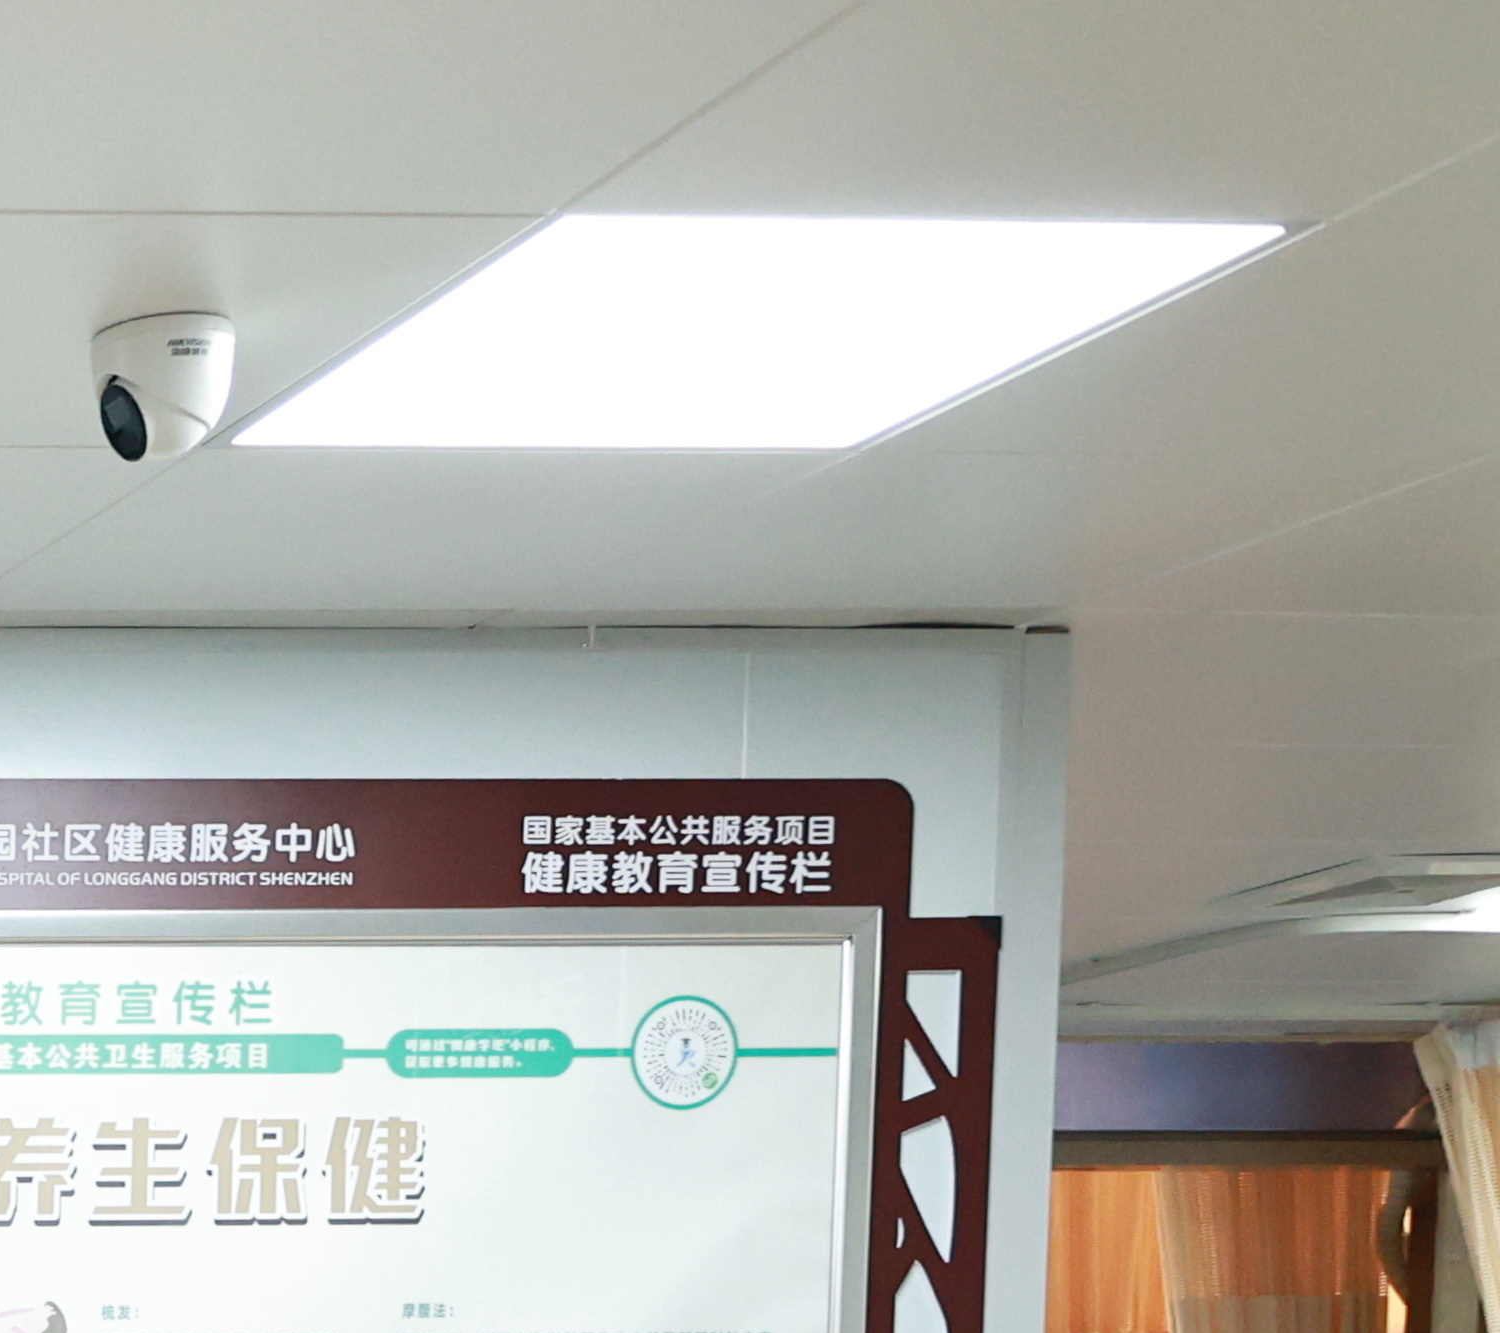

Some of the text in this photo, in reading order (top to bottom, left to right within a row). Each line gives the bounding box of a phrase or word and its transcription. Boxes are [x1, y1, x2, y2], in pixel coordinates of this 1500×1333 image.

[521, 815, 837, 848] 国家基本公共服务项目
[57, 871, 81, 887] OF
[84, 871, 177, 887] LONGGANG
[181, 871, 256, 887] DISTRICT
[259, 871, 354, 886] SHENZHEN
[521, 851, 833, 895] 健康教育宣传栏
